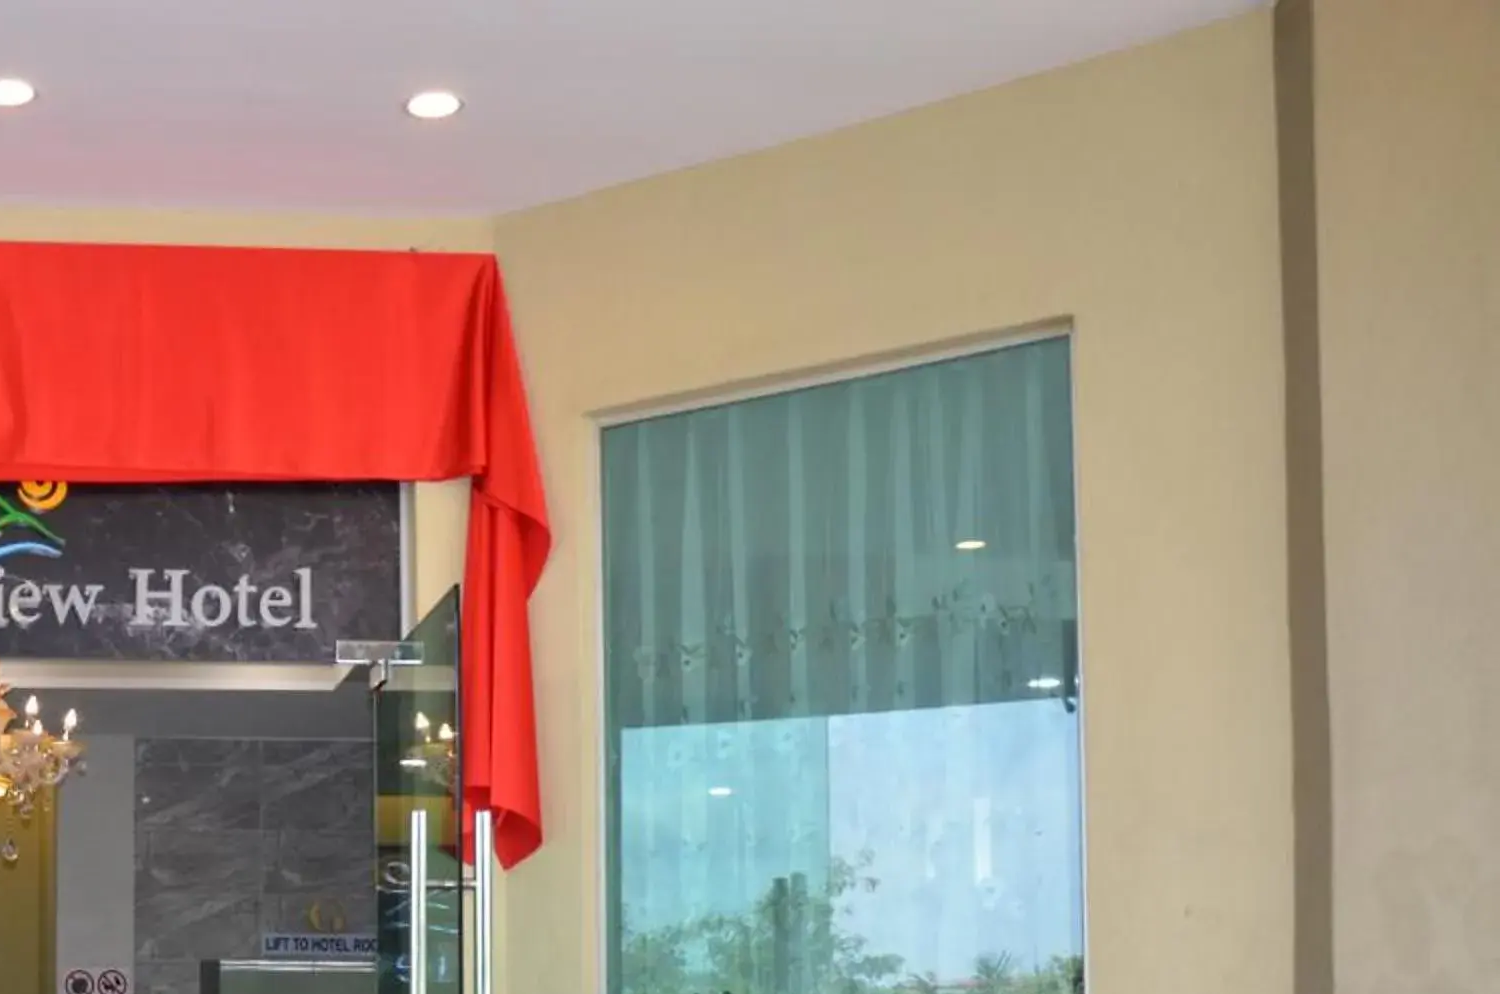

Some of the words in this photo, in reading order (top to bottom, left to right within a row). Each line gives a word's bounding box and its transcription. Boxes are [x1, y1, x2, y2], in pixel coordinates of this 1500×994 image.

[128, 567, 318, 628] Hotel
[265, 937, 289, 951] LIFT
[293, 937, 309, 951] TO
[311, 937, 351, 952] HOTEL
